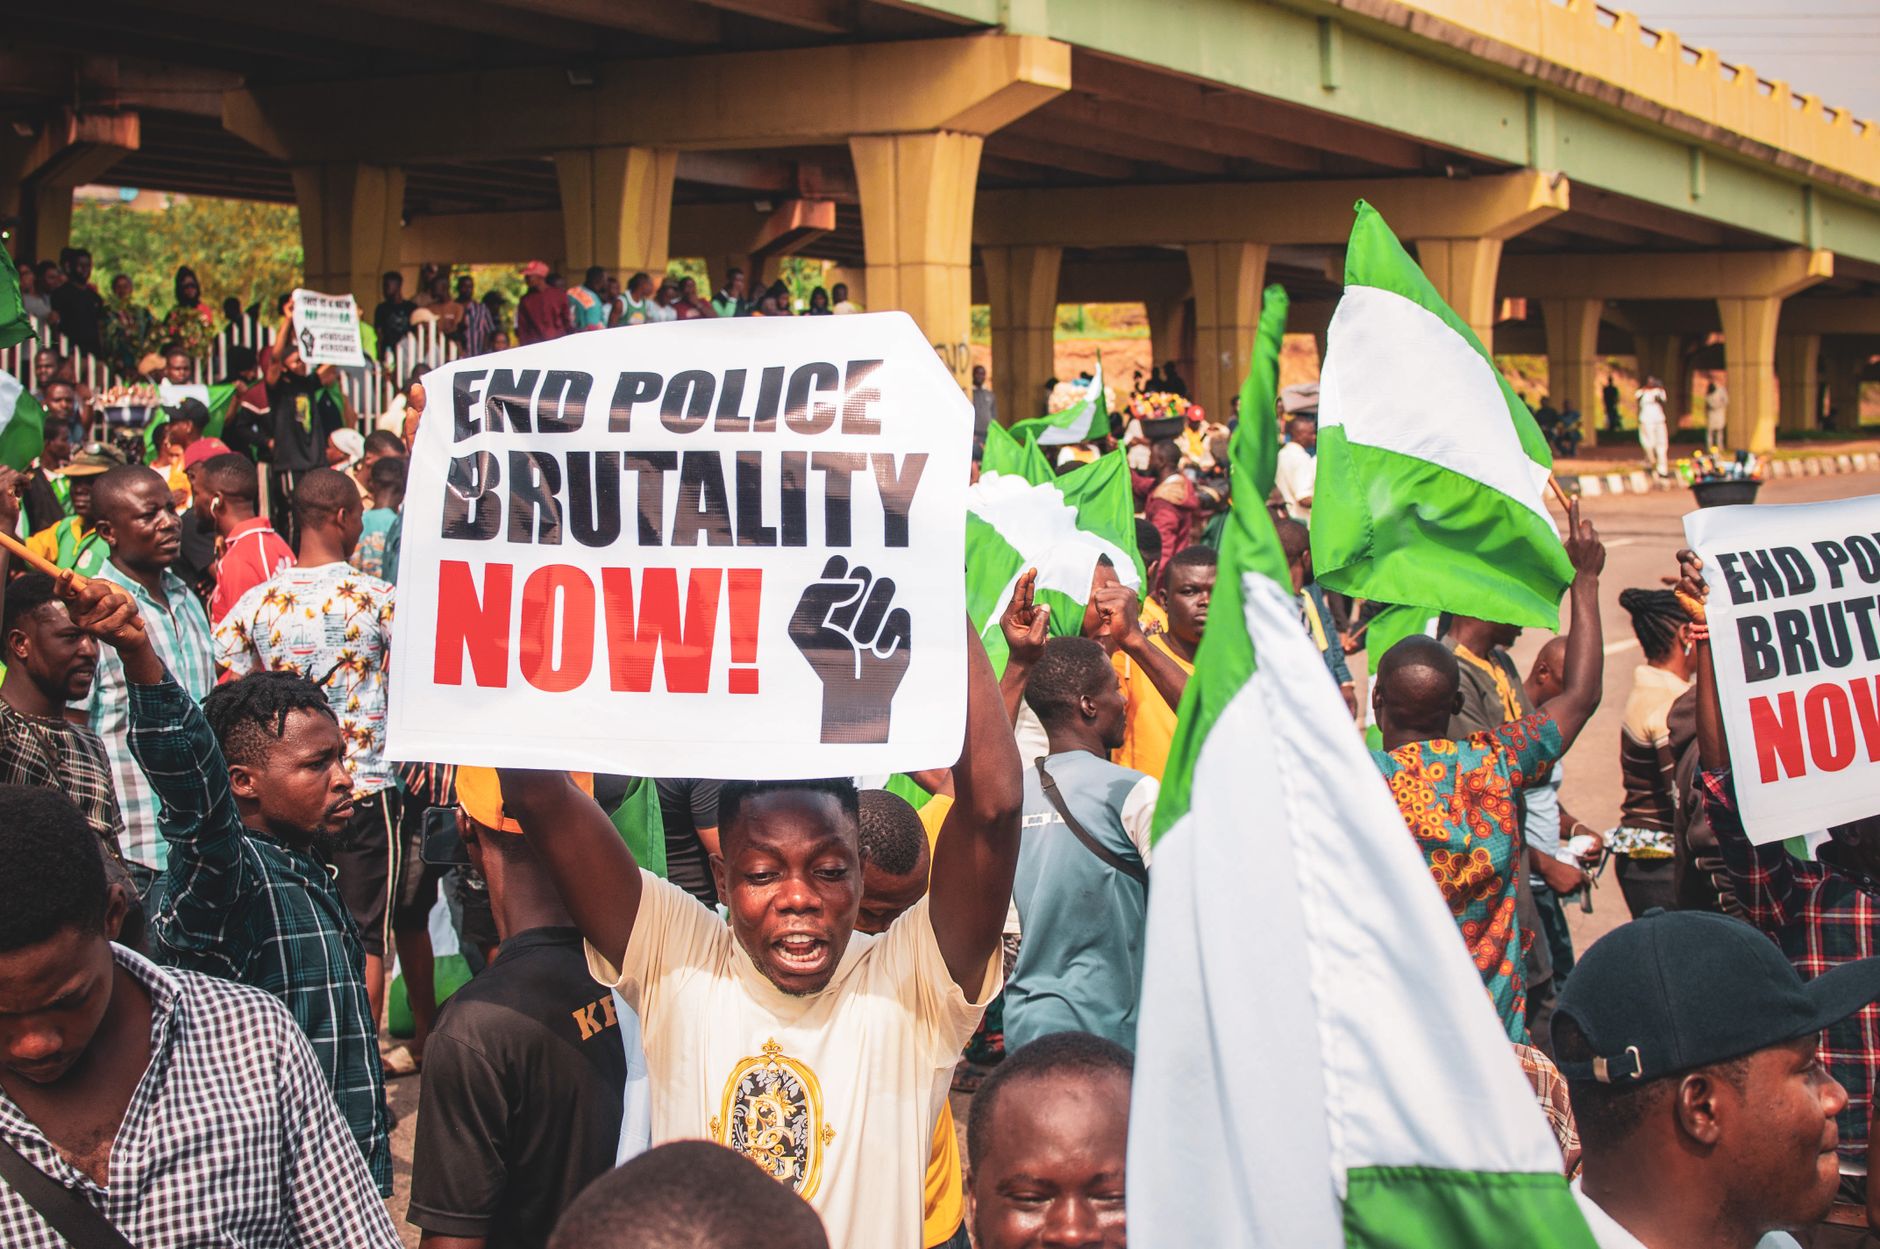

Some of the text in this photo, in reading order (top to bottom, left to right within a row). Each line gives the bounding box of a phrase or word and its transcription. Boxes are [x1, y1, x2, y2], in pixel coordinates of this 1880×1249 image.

[453, 359, 884, 443] END POLICE
[441, 450, 929, 547] BRUTALITY
[1715, 532, 1880, 605] END PO
[434, 560, 763, 694] NOW!
[1736, 594, 1880, 684] BRUT
